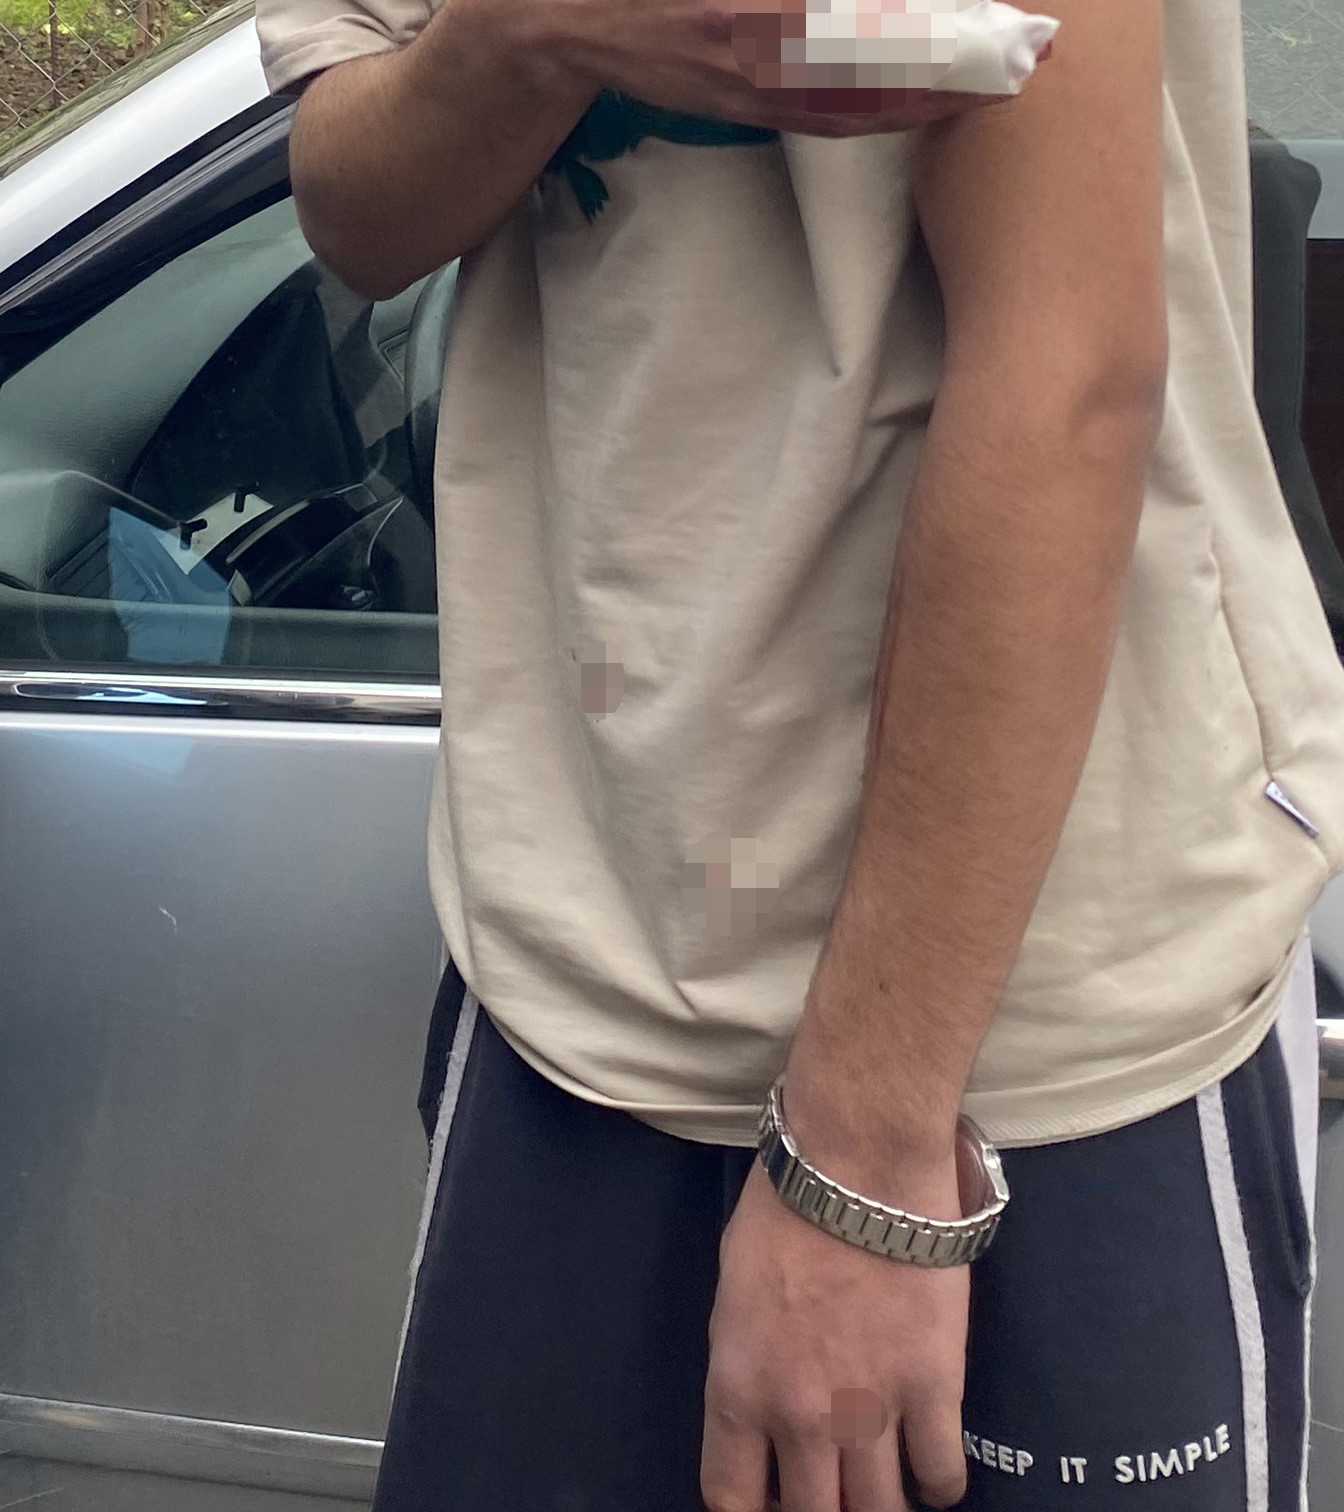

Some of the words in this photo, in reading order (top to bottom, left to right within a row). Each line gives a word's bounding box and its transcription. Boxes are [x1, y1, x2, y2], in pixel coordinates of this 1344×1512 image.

[963, 1430, 1034, 1476] KEEP
[1060, 1456, 1087, 1484] IT
[1115, 1423, 1231, 1484] SIMPLE
